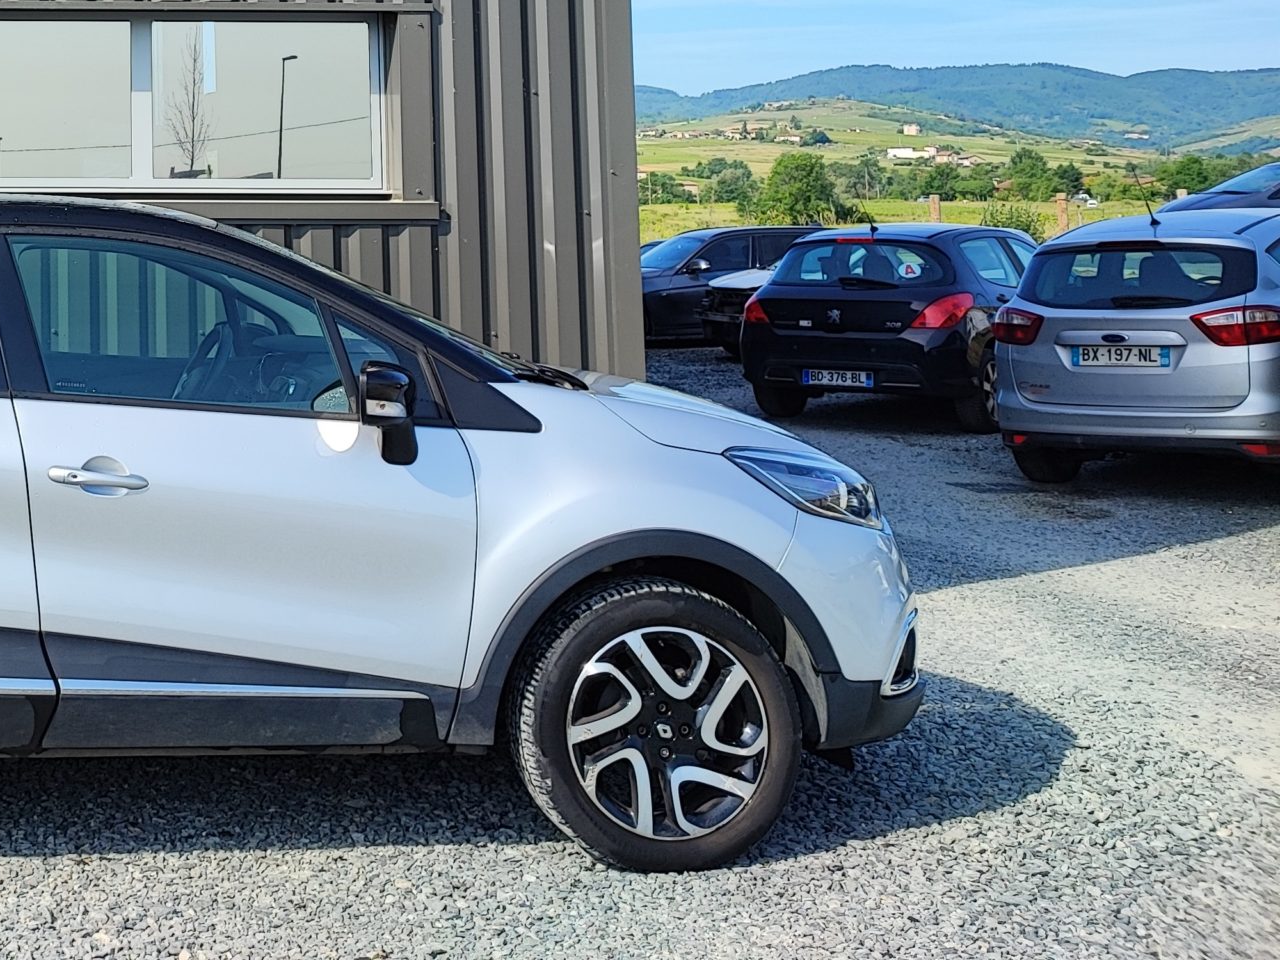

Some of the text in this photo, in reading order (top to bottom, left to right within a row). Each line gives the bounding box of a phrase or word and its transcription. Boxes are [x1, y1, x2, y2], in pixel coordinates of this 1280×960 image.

[904, 264, 917, 276] A
[1082, 347, 1158, 363] BX-197-NL
[810, 370, 865, 384] BD-376-BL
